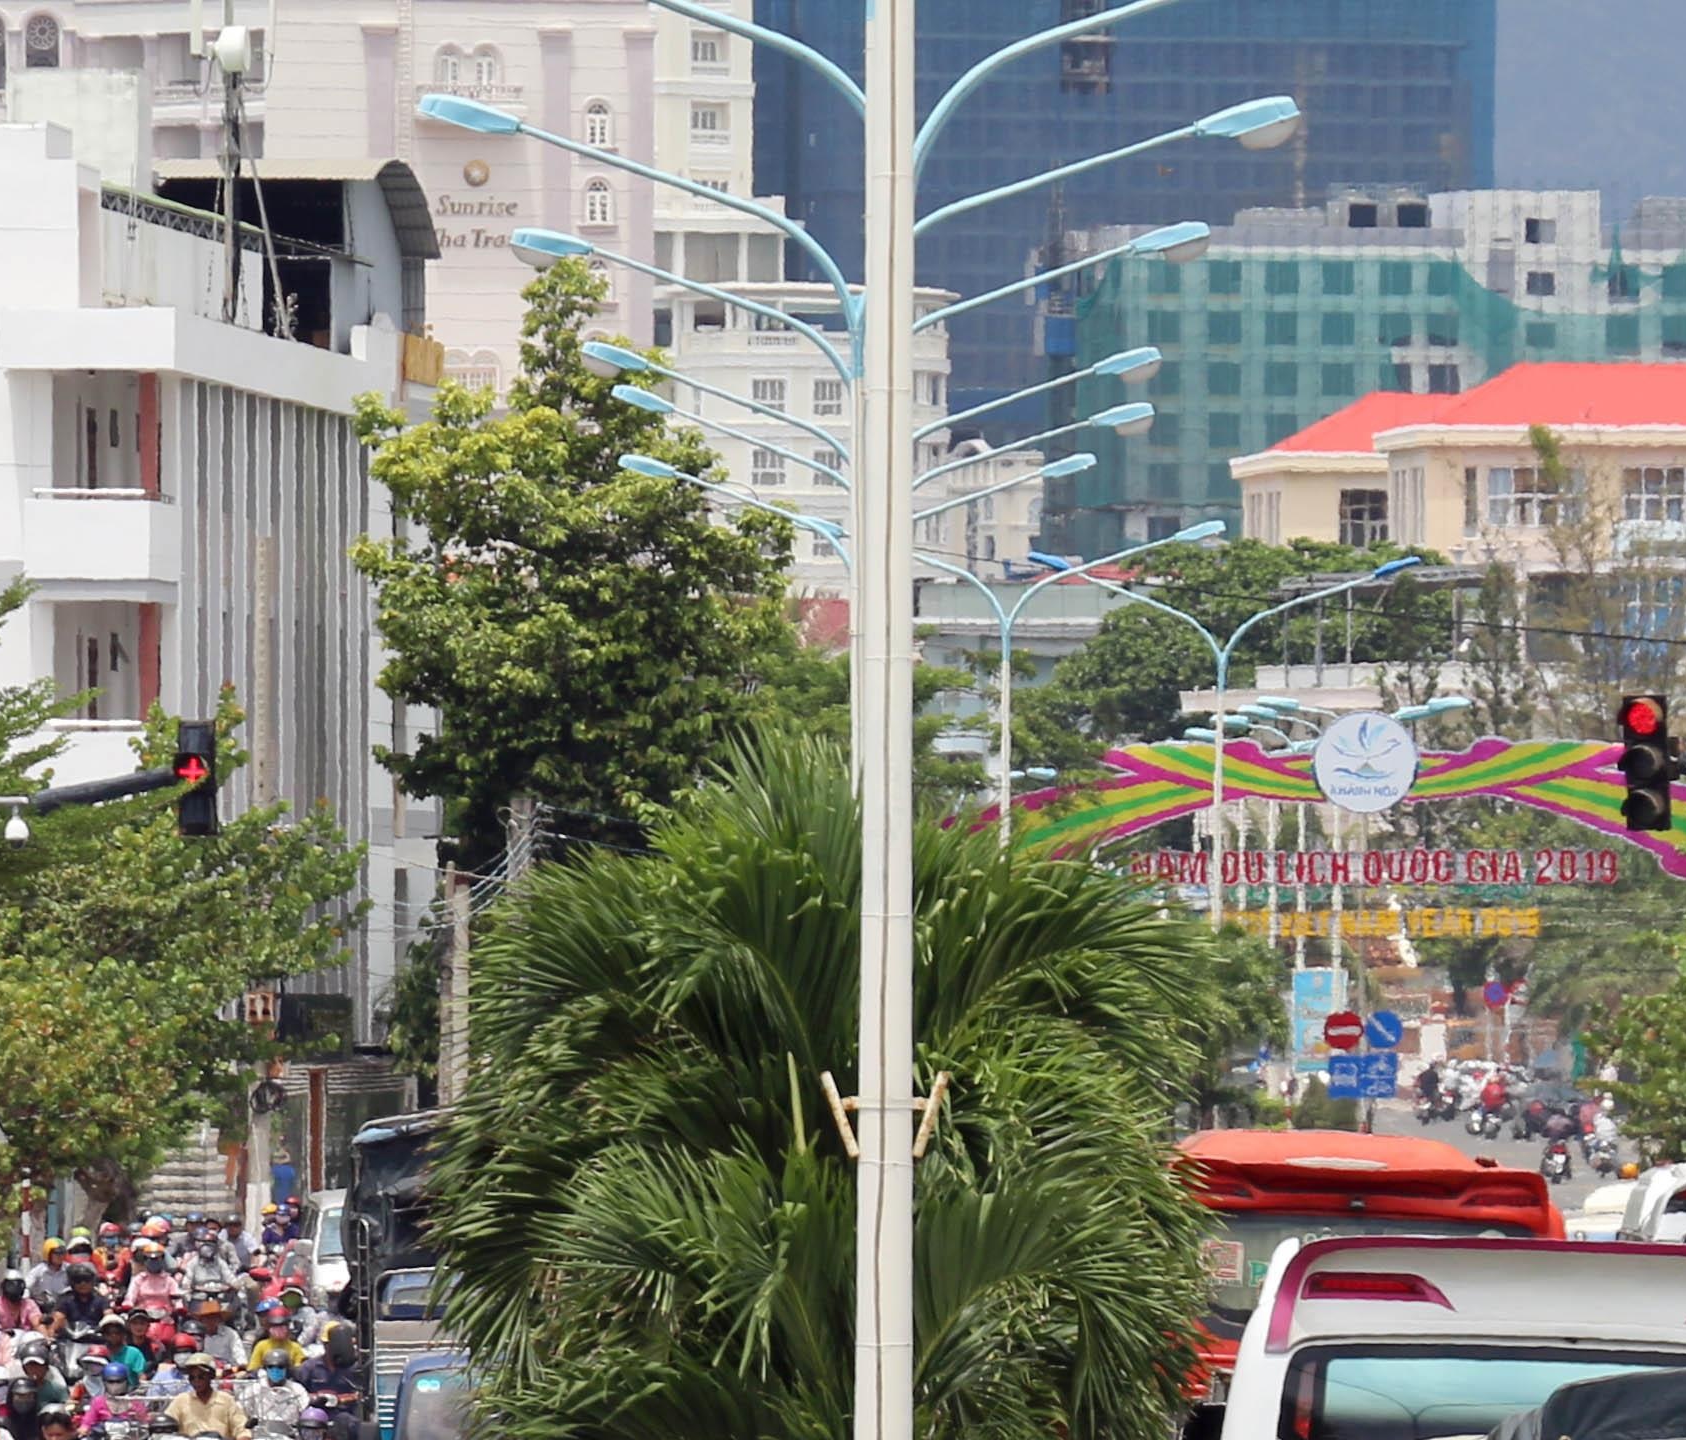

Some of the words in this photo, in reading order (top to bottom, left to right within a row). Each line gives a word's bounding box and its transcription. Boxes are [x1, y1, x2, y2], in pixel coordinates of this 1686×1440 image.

[436, 195, 518, 216] Sunrise
[433, 228, 466, 248] ha
[471, 228, 511, 248] Tra
[1220, 849, 1265, 885] DU
[1465, 848, 1522, 885] GIA
[1535, 847, 1619, 886] 2019
